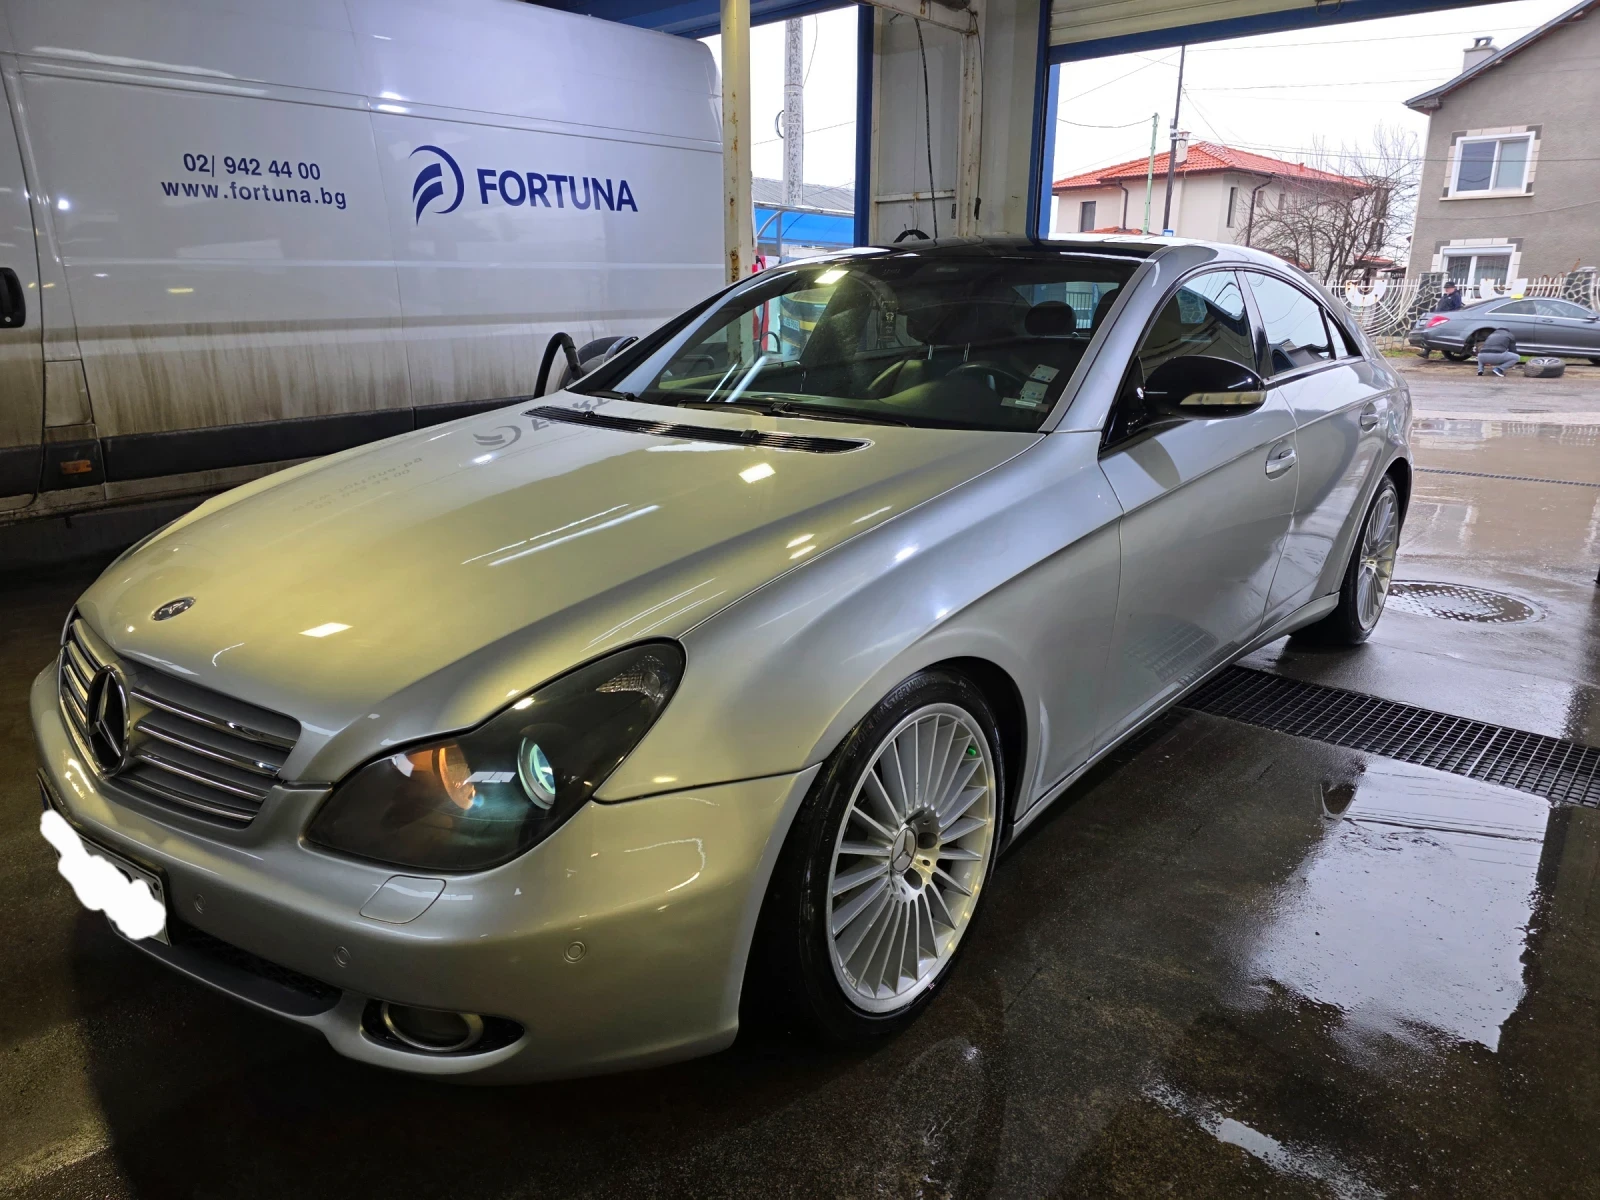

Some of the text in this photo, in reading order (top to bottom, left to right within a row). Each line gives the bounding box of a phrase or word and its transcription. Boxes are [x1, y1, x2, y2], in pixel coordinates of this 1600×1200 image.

[223, 156, 262, 176] 942
[268, 160, 293, 178] 44
[297, 162, 321, 180] 00
[161, 181, 347, 210] www.fortuna.bg
[476, 168, 639, 212] FORTUNA
